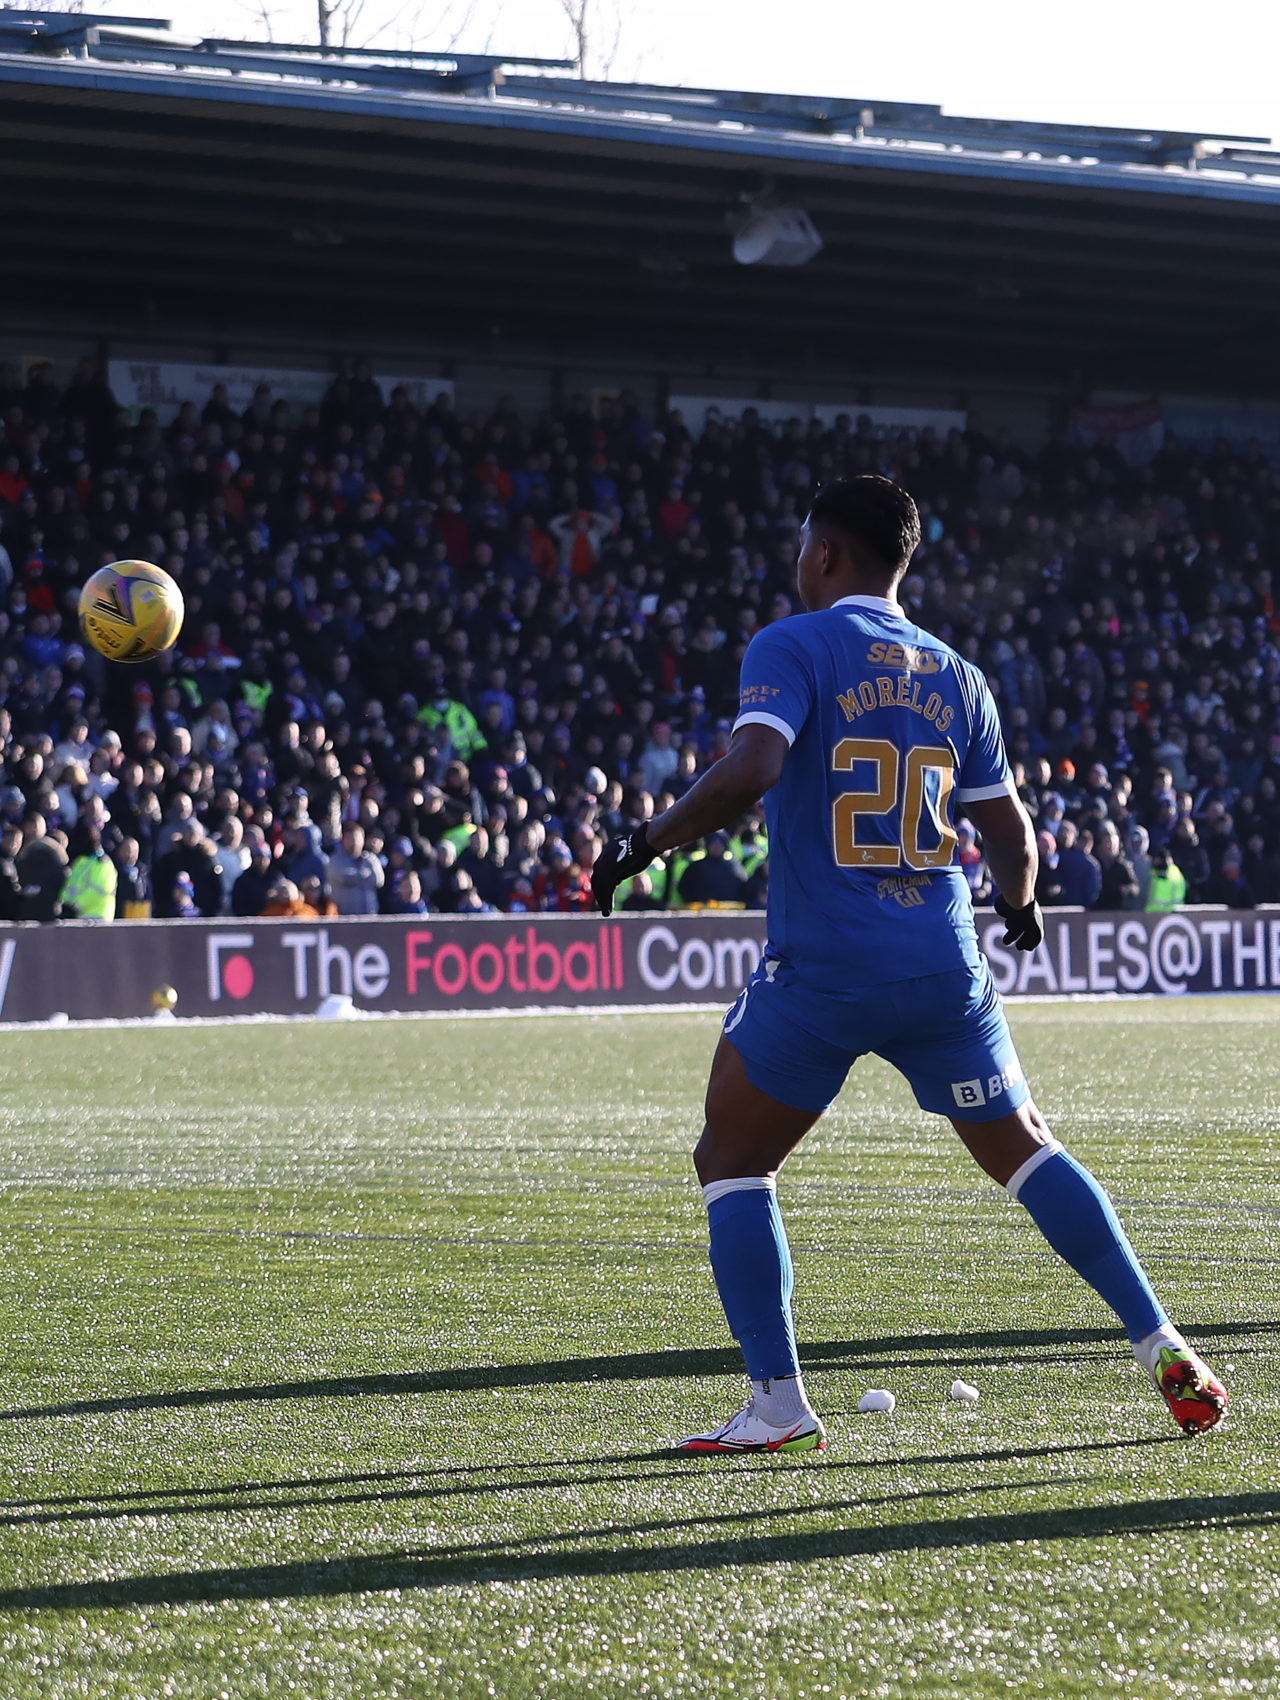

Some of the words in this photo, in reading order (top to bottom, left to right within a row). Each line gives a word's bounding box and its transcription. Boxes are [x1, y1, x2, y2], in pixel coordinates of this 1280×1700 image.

[836, 676, 955, 732] MORELOS
[832, 736, 960, 871] 20
[281, 929, 391, 998] The
[405, 925, 624, 995] Football
[637, 925, 760, 991] Com
